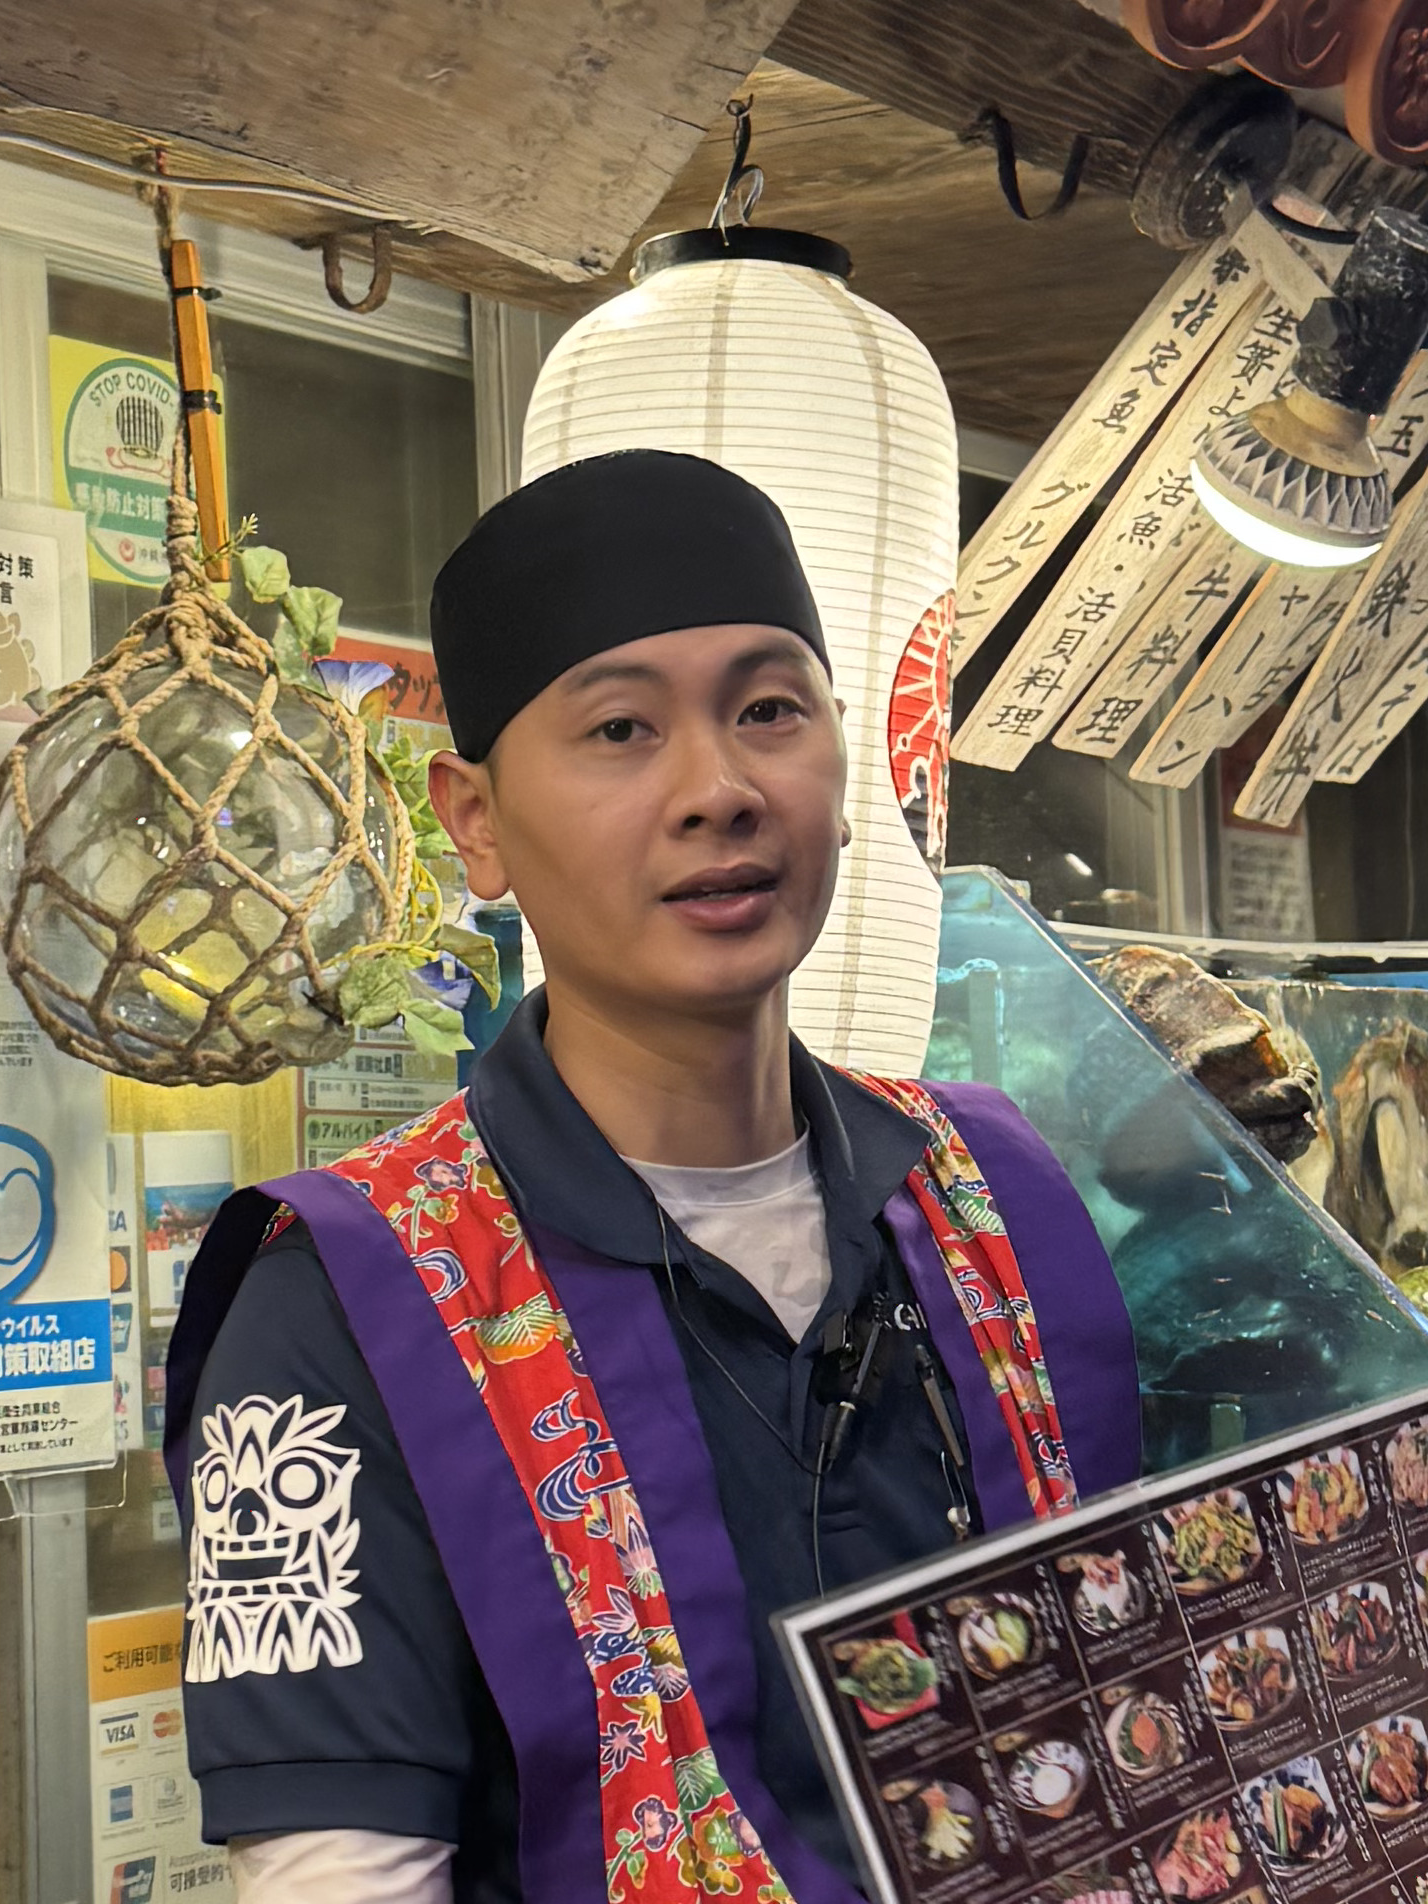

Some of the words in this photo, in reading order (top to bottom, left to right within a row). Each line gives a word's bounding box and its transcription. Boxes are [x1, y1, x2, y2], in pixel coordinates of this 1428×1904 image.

[89, 371, 121, 407] STOP
[987, 467, 1196, 736] 活魚・活貝料理
[106, 1722, 136, 1744] VISA
